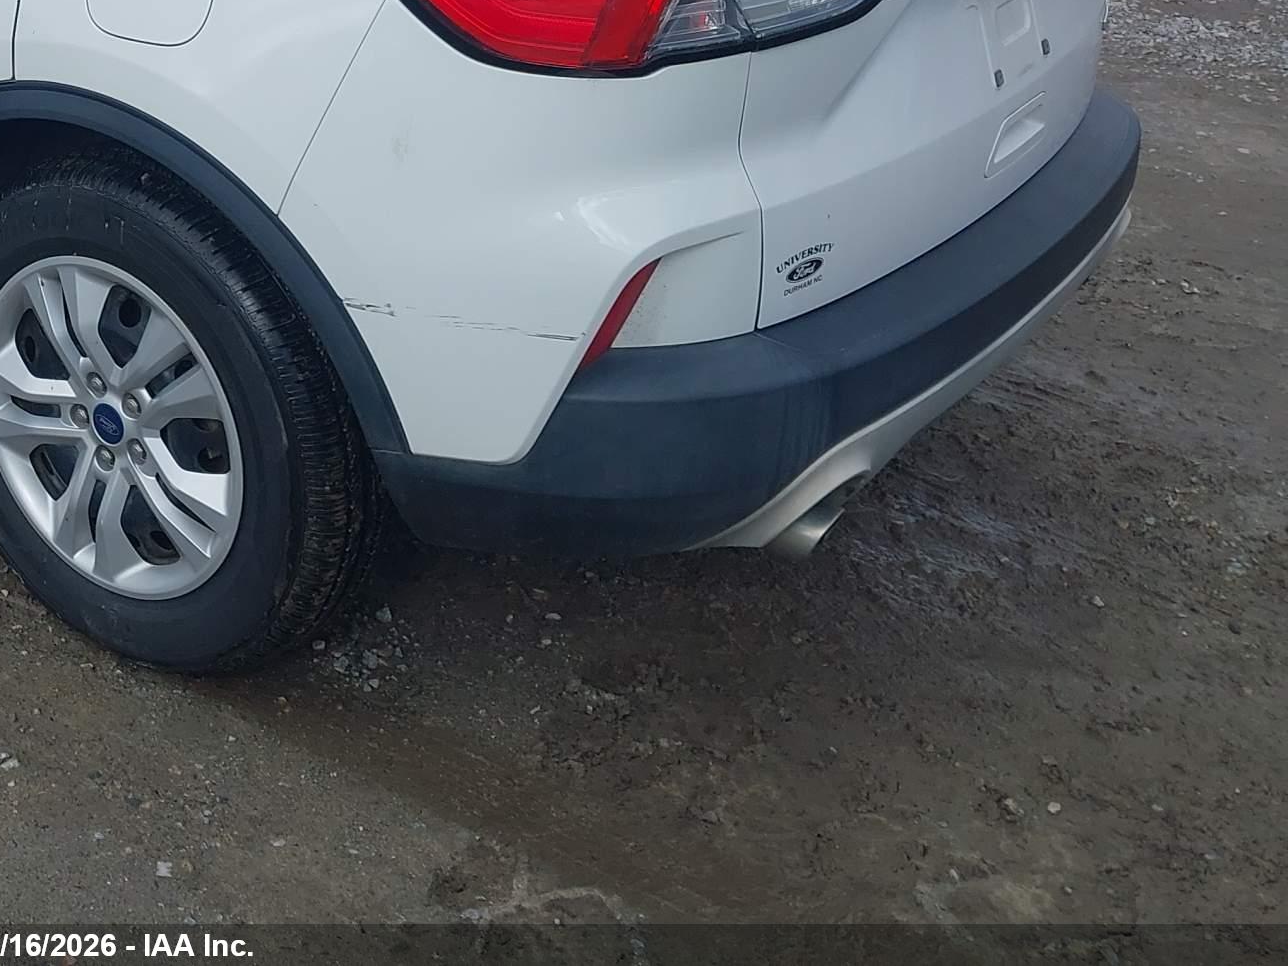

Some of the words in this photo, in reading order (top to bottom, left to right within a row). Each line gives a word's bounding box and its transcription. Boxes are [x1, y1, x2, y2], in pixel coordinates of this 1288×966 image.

[776, 242, 835, 274] UNIVERSITY
[783, 279, 813, 297] DURHAM
[813, 274, 824, 284] NC
